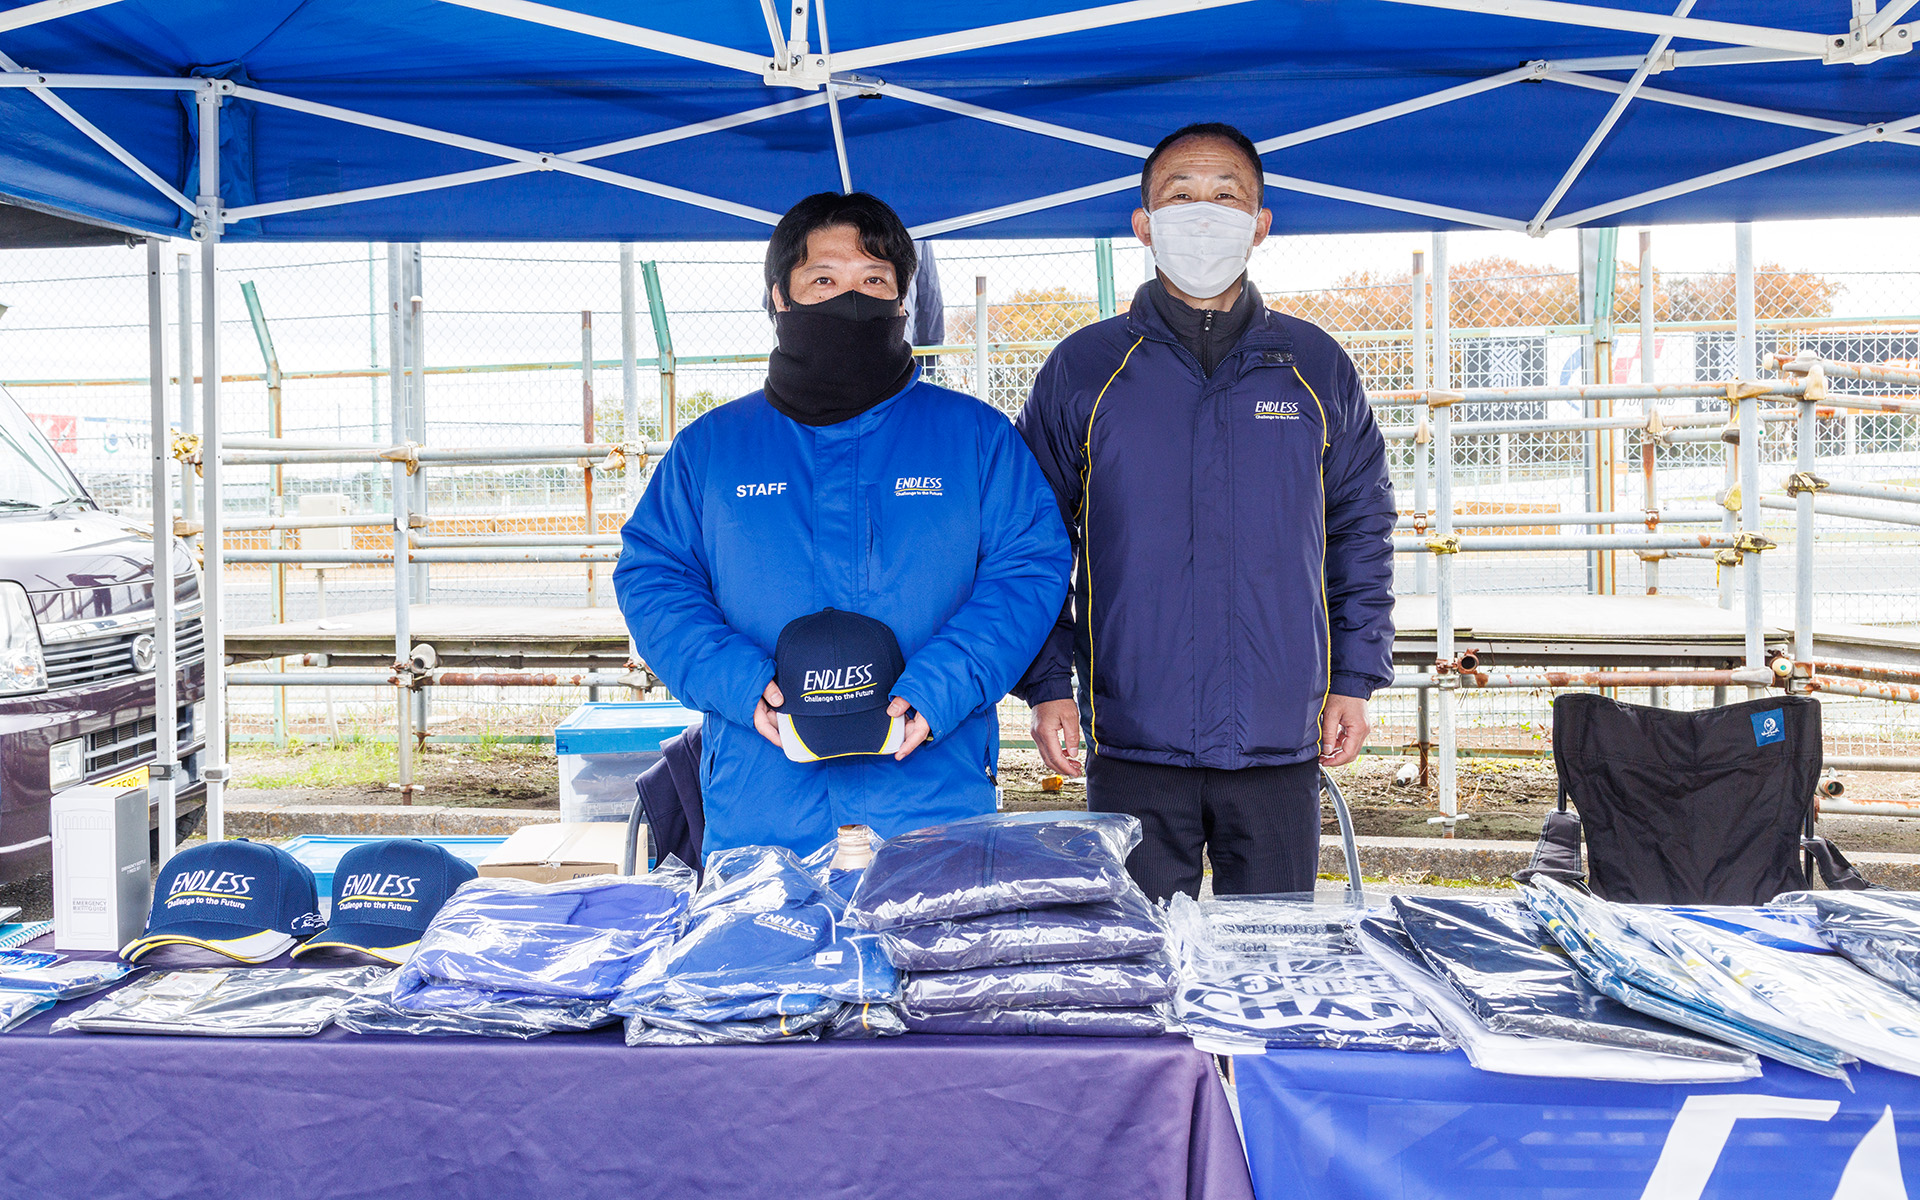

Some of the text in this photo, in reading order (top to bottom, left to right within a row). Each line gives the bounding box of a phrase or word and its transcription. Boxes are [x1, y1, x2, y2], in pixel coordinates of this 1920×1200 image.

[1255, 401, 1299, 413] ENDLESS
[736, 482, 787, 498] STAFF
[895, 477, 943, 490] ENDLESS
[803, 663, 873, 691] ENDLESS
[804, 695, 834, 703] Challenge
[844, 692, 855, 700] the
[855, 689, 875, 698] Future
[168, 869, 256, 896] ENDLESS
[341, 873, 421, 897] ENDLESS
[167, 896, 246, 910] Challenge to the Future
[339, 901, 363, 911] Challenge
[373, 901, 386, 909] the
[387, 902, 412, 912] Future
[755, 912, 819, 935] ENDLESS
